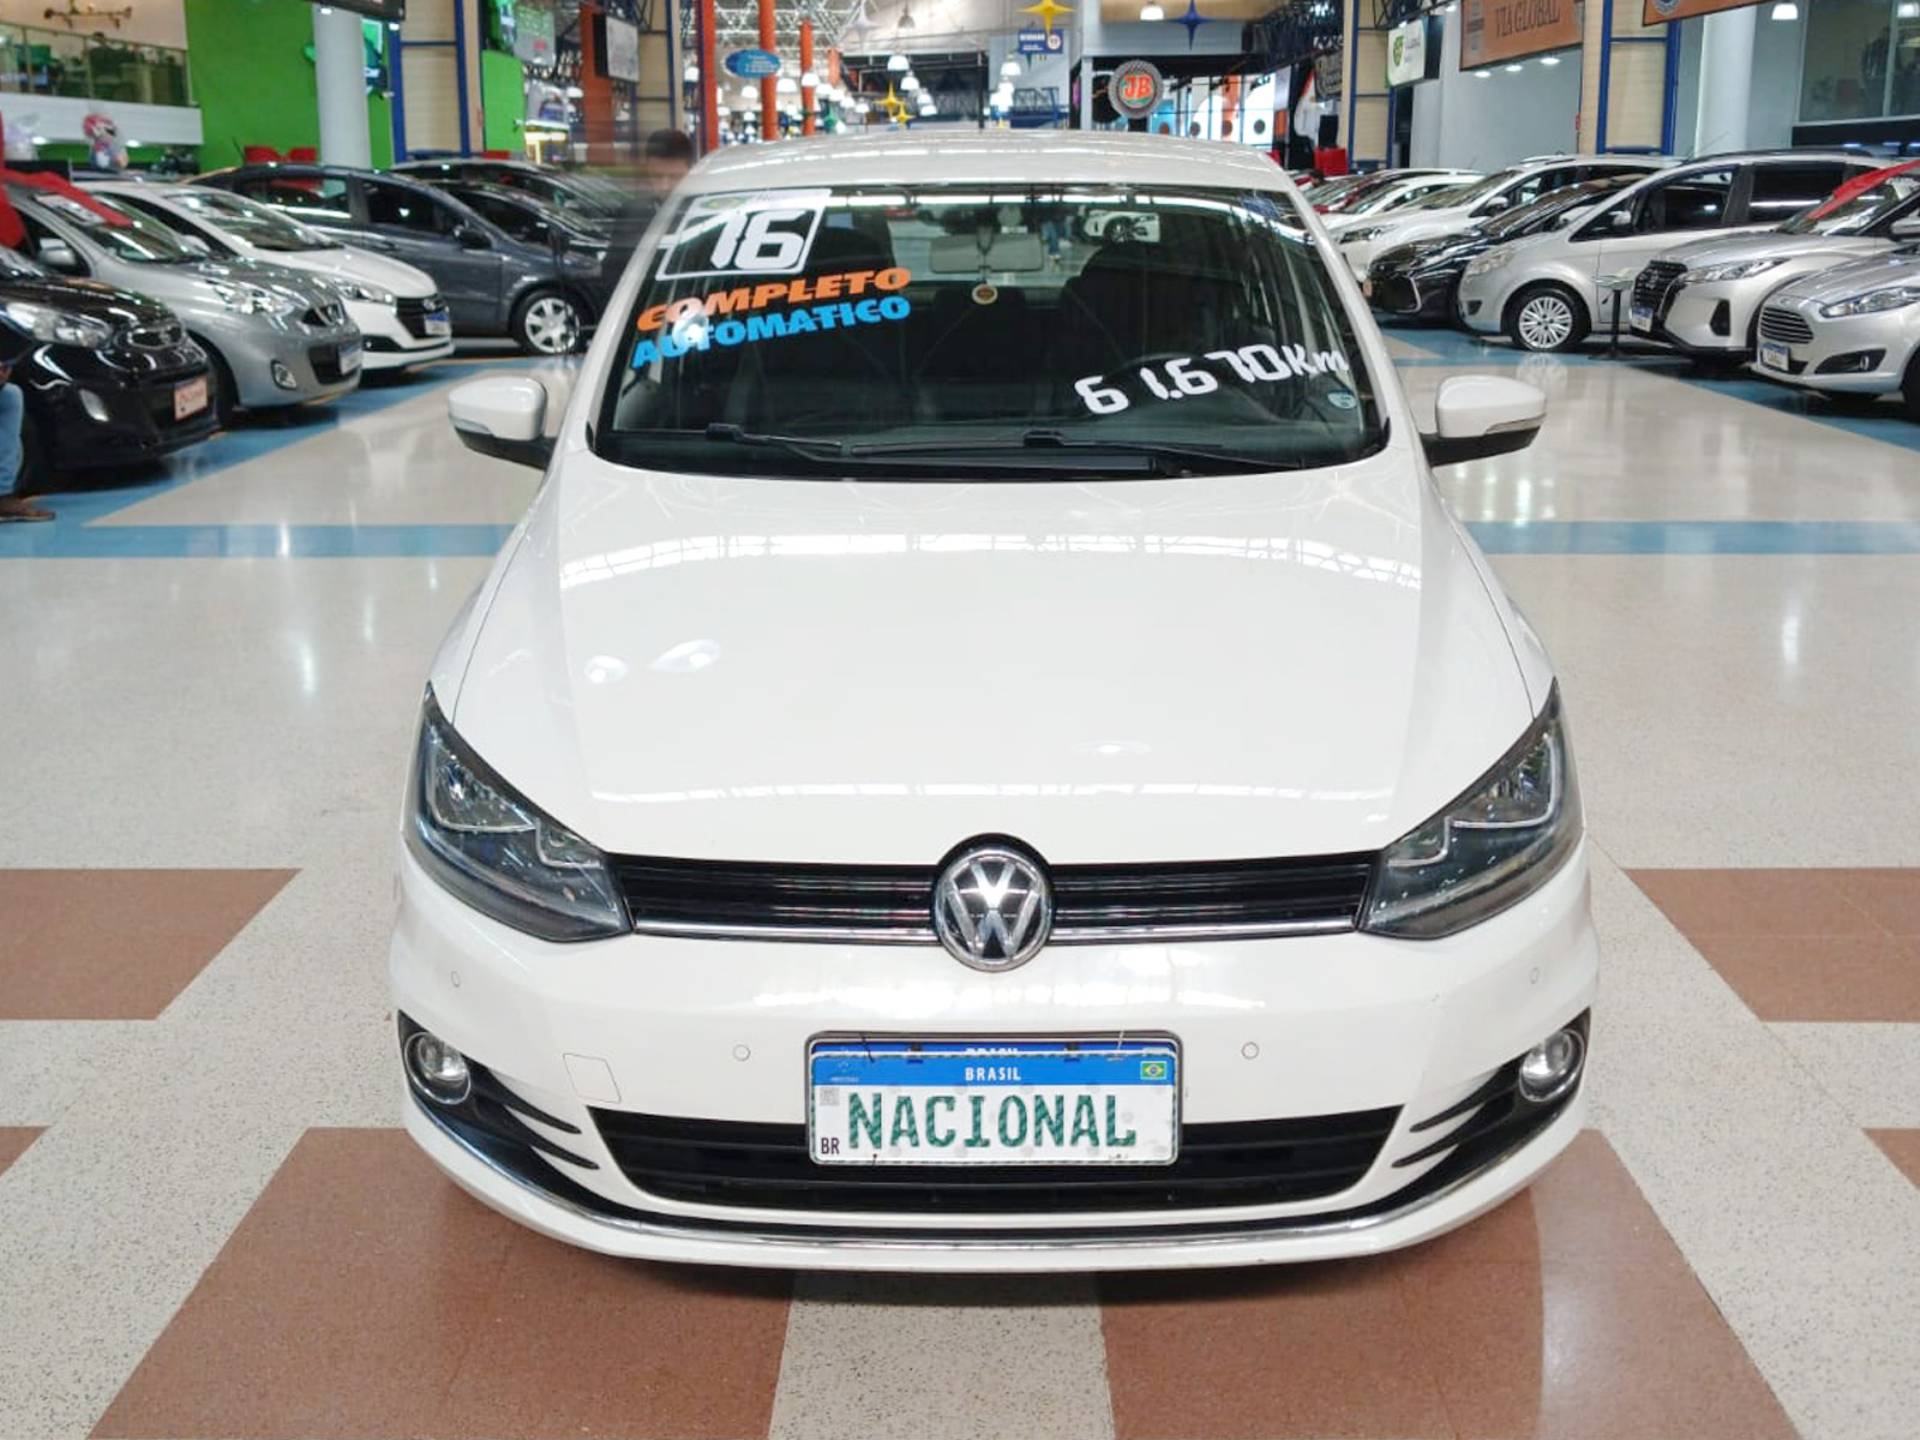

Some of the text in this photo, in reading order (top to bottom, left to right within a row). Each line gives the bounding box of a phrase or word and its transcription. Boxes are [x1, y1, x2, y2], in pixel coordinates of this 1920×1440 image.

[1124, 74, 1153, 98] JB
[637, 267, 911, 332] COMPLETO
[631, 296, 911, 369] AUTOMATICO
[965, 1066, 1021, 1081] BRASIL
[848, 1092, 1137, 1149] NACIONAL
[820, 1137, 840, 1155] BR
